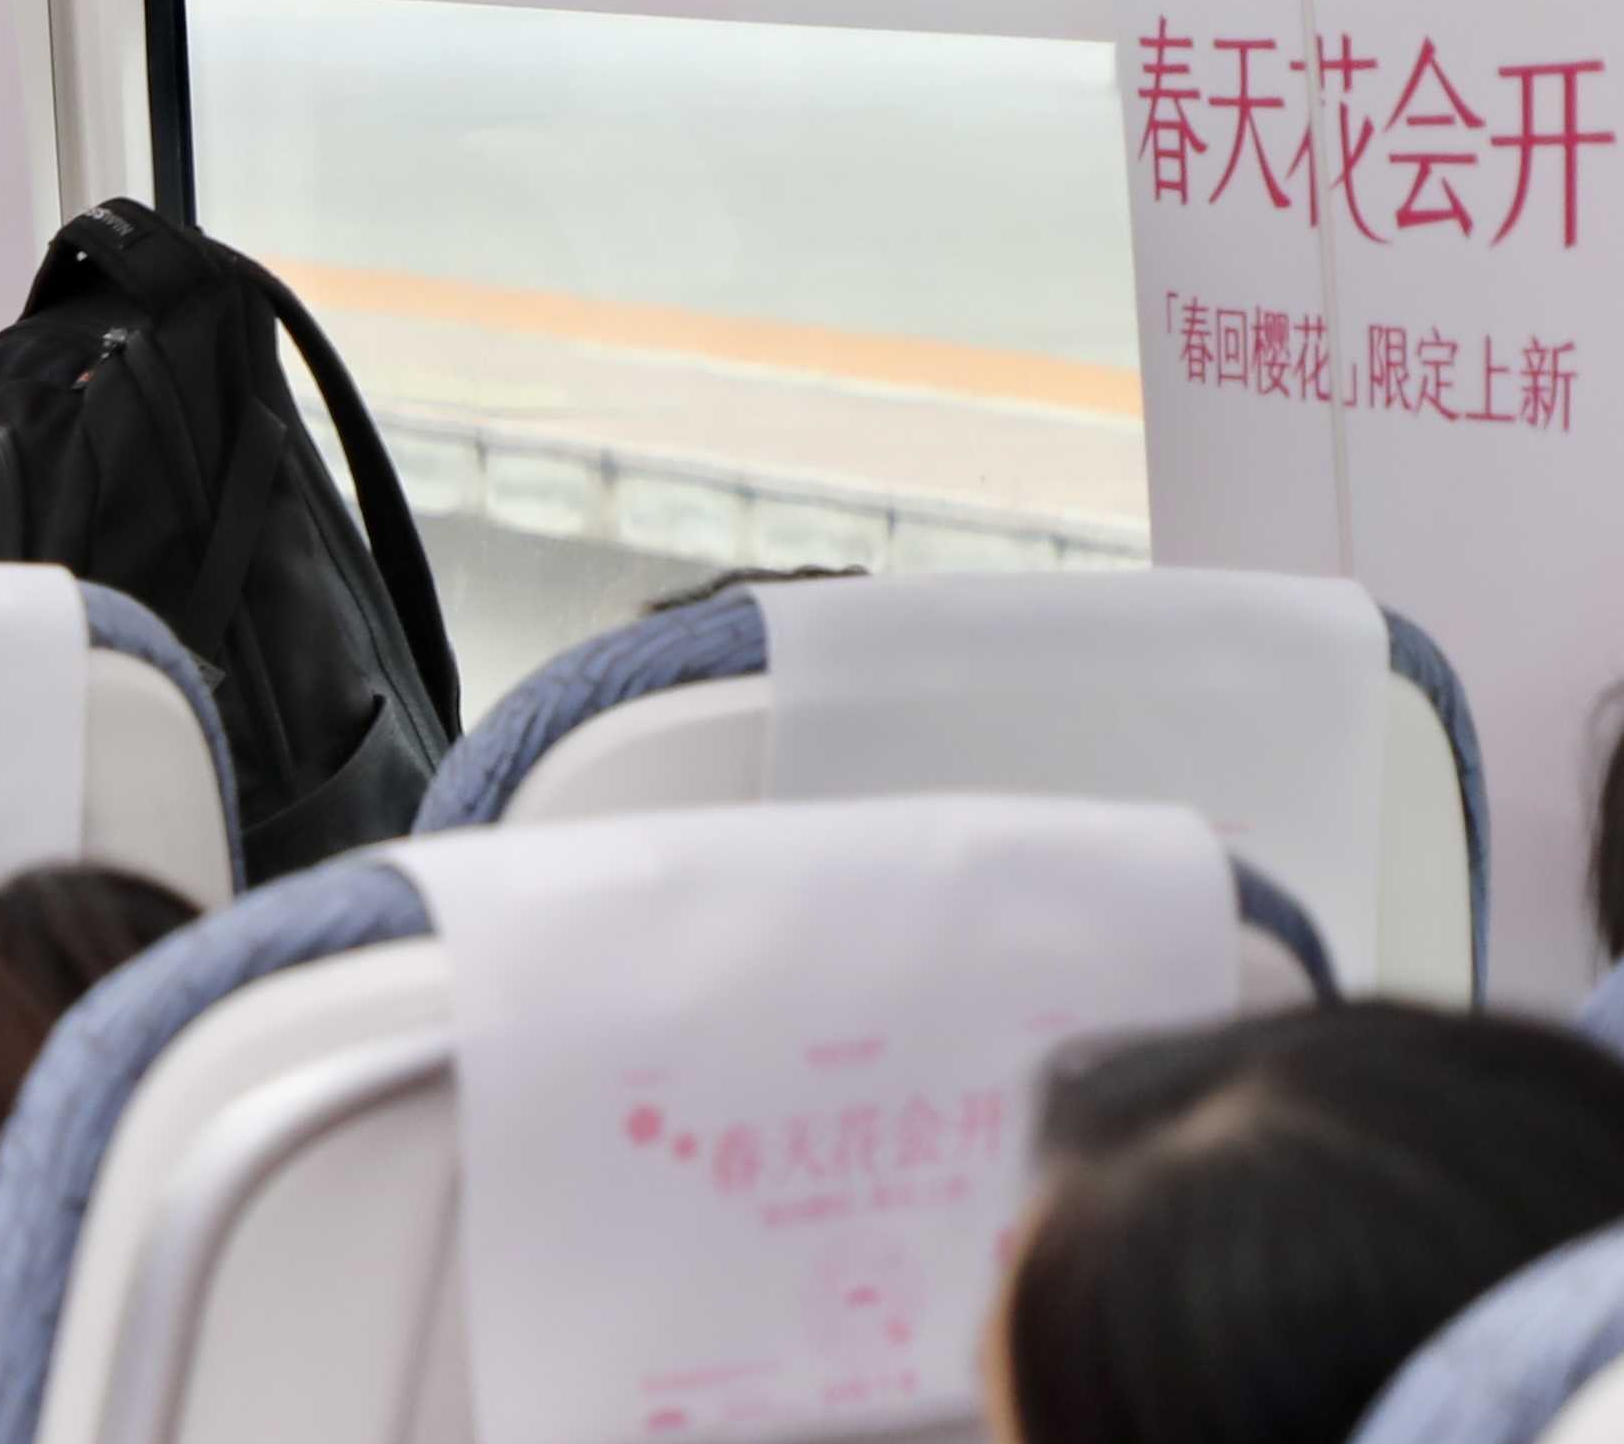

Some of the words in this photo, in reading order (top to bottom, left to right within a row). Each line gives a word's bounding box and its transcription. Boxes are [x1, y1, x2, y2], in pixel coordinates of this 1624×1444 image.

[1138, 13, 1617, 249] 春天花会开
[1165, 289, 1579, 434] 「春回樱花」限定上新
